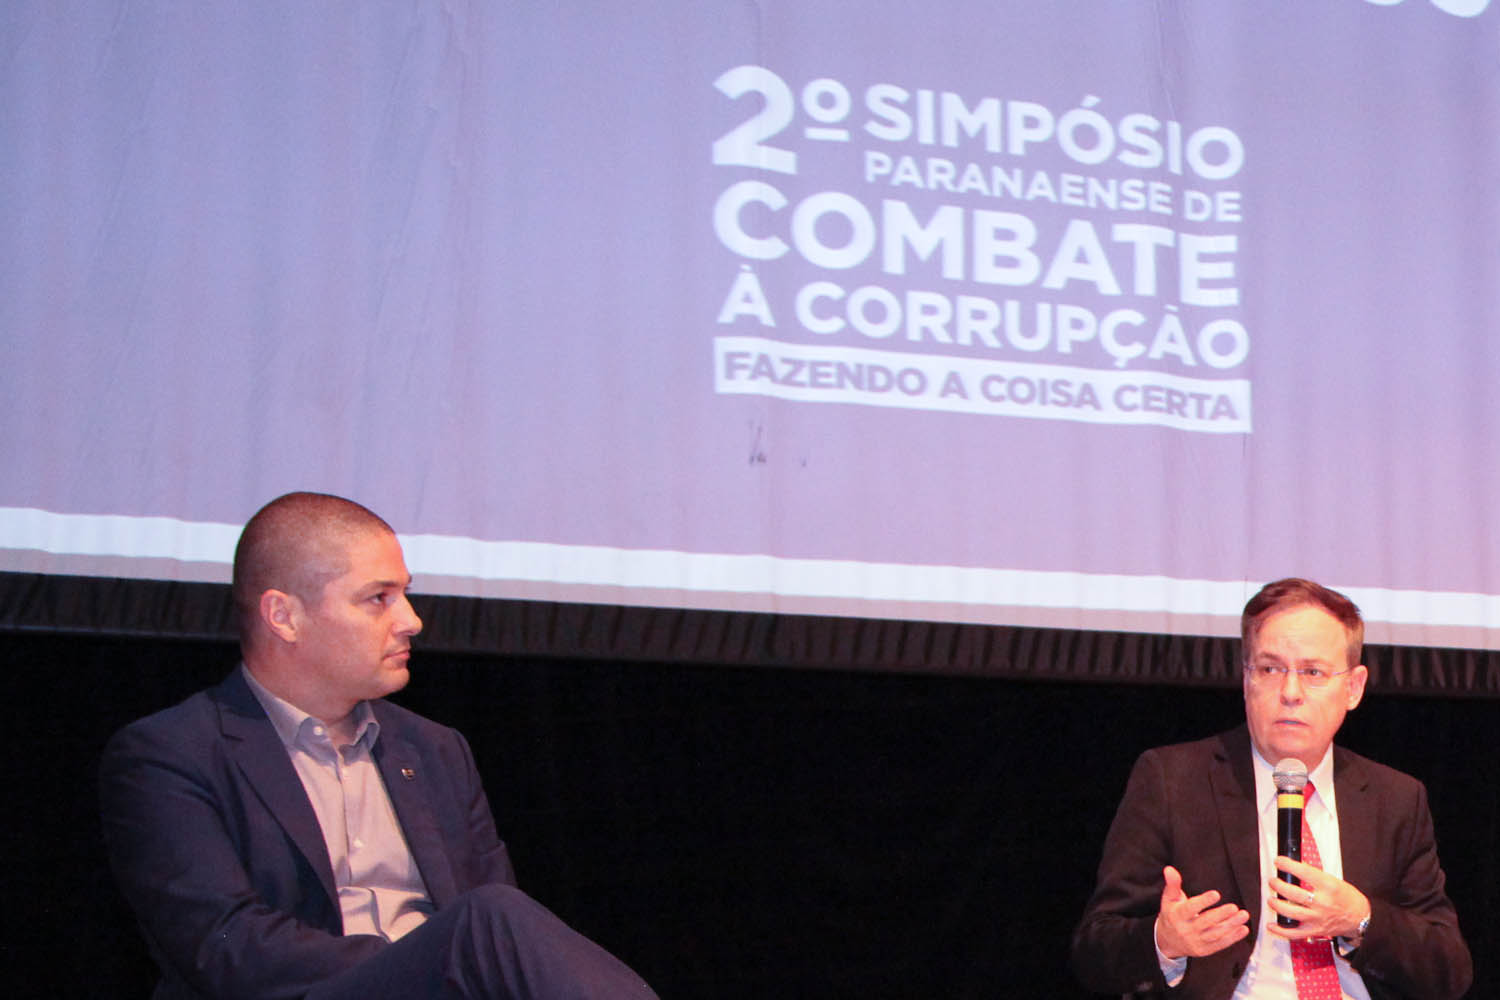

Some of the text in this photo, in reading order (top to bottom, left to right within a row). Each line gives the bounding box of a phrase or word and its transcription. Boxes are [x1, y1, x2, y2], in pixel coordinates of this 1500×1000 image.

[864, 84, 1245, 180] SIMPÓSIO
[865, 151, 1243, 223] PARANAENSE DE
[713, 180, 1240, 307] COMBATE
[795, 281, 1251, 369] CORRUPÇÃO
[724, 351, 1240, 421] FAZENDO A COISA CERTA
